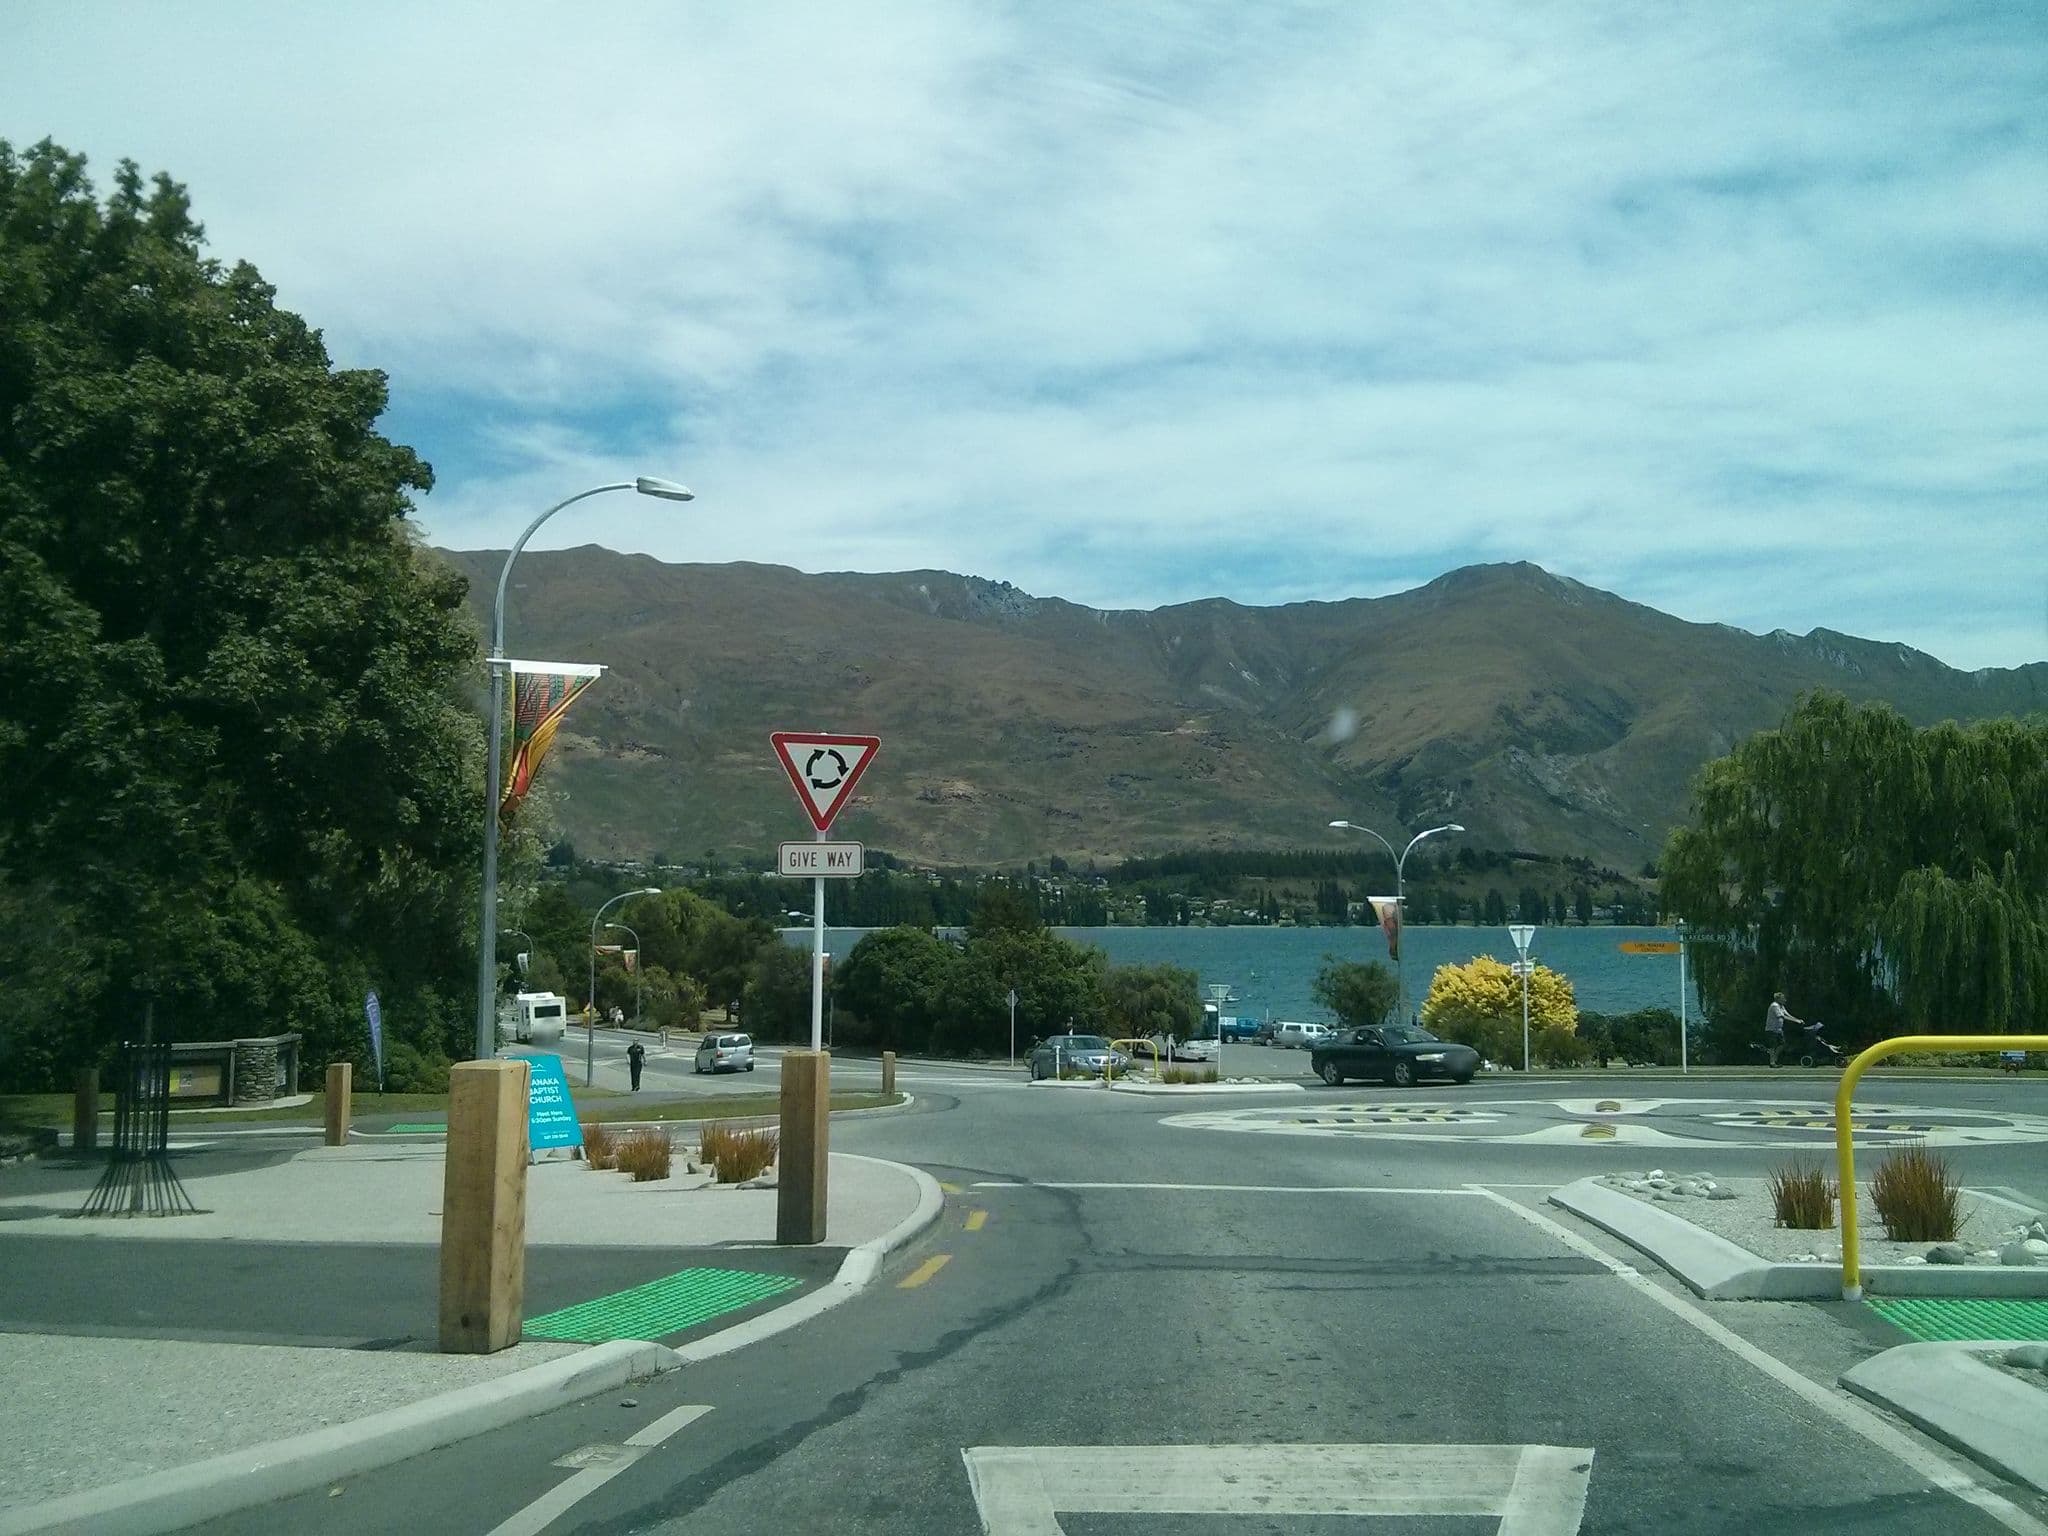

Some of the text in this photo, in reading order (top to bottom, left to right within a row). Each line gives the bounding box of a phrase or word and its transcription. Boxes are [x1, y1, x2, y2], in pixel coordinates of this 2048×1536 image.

[789, 851, 853, 867] GIVE WAY
[531, 1078, 559, 1086] ANAKA
[529, 1095, 563, 1104] CHURCH
